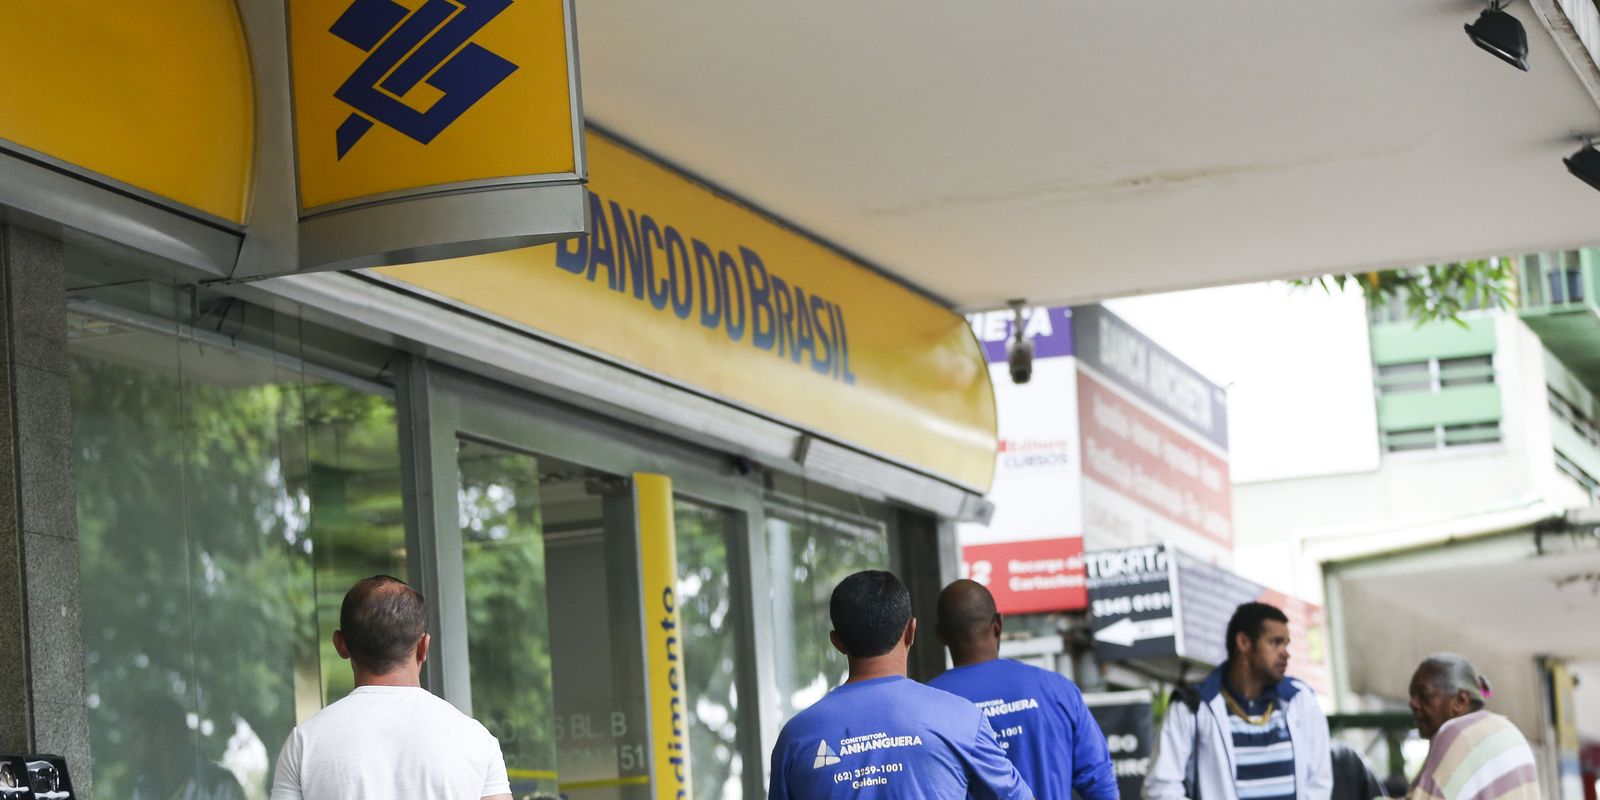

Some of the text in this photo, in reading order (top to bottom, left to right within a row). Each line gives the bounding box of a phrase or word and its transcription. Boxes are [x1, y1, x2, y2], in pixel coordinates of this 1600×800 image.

[691, 237, 746, 343] DO
[738, 244, 856, 386] BRASIL
[840, 736, 922, 756] ANHANGUERA
[833, 771, 852, 784] (62)
